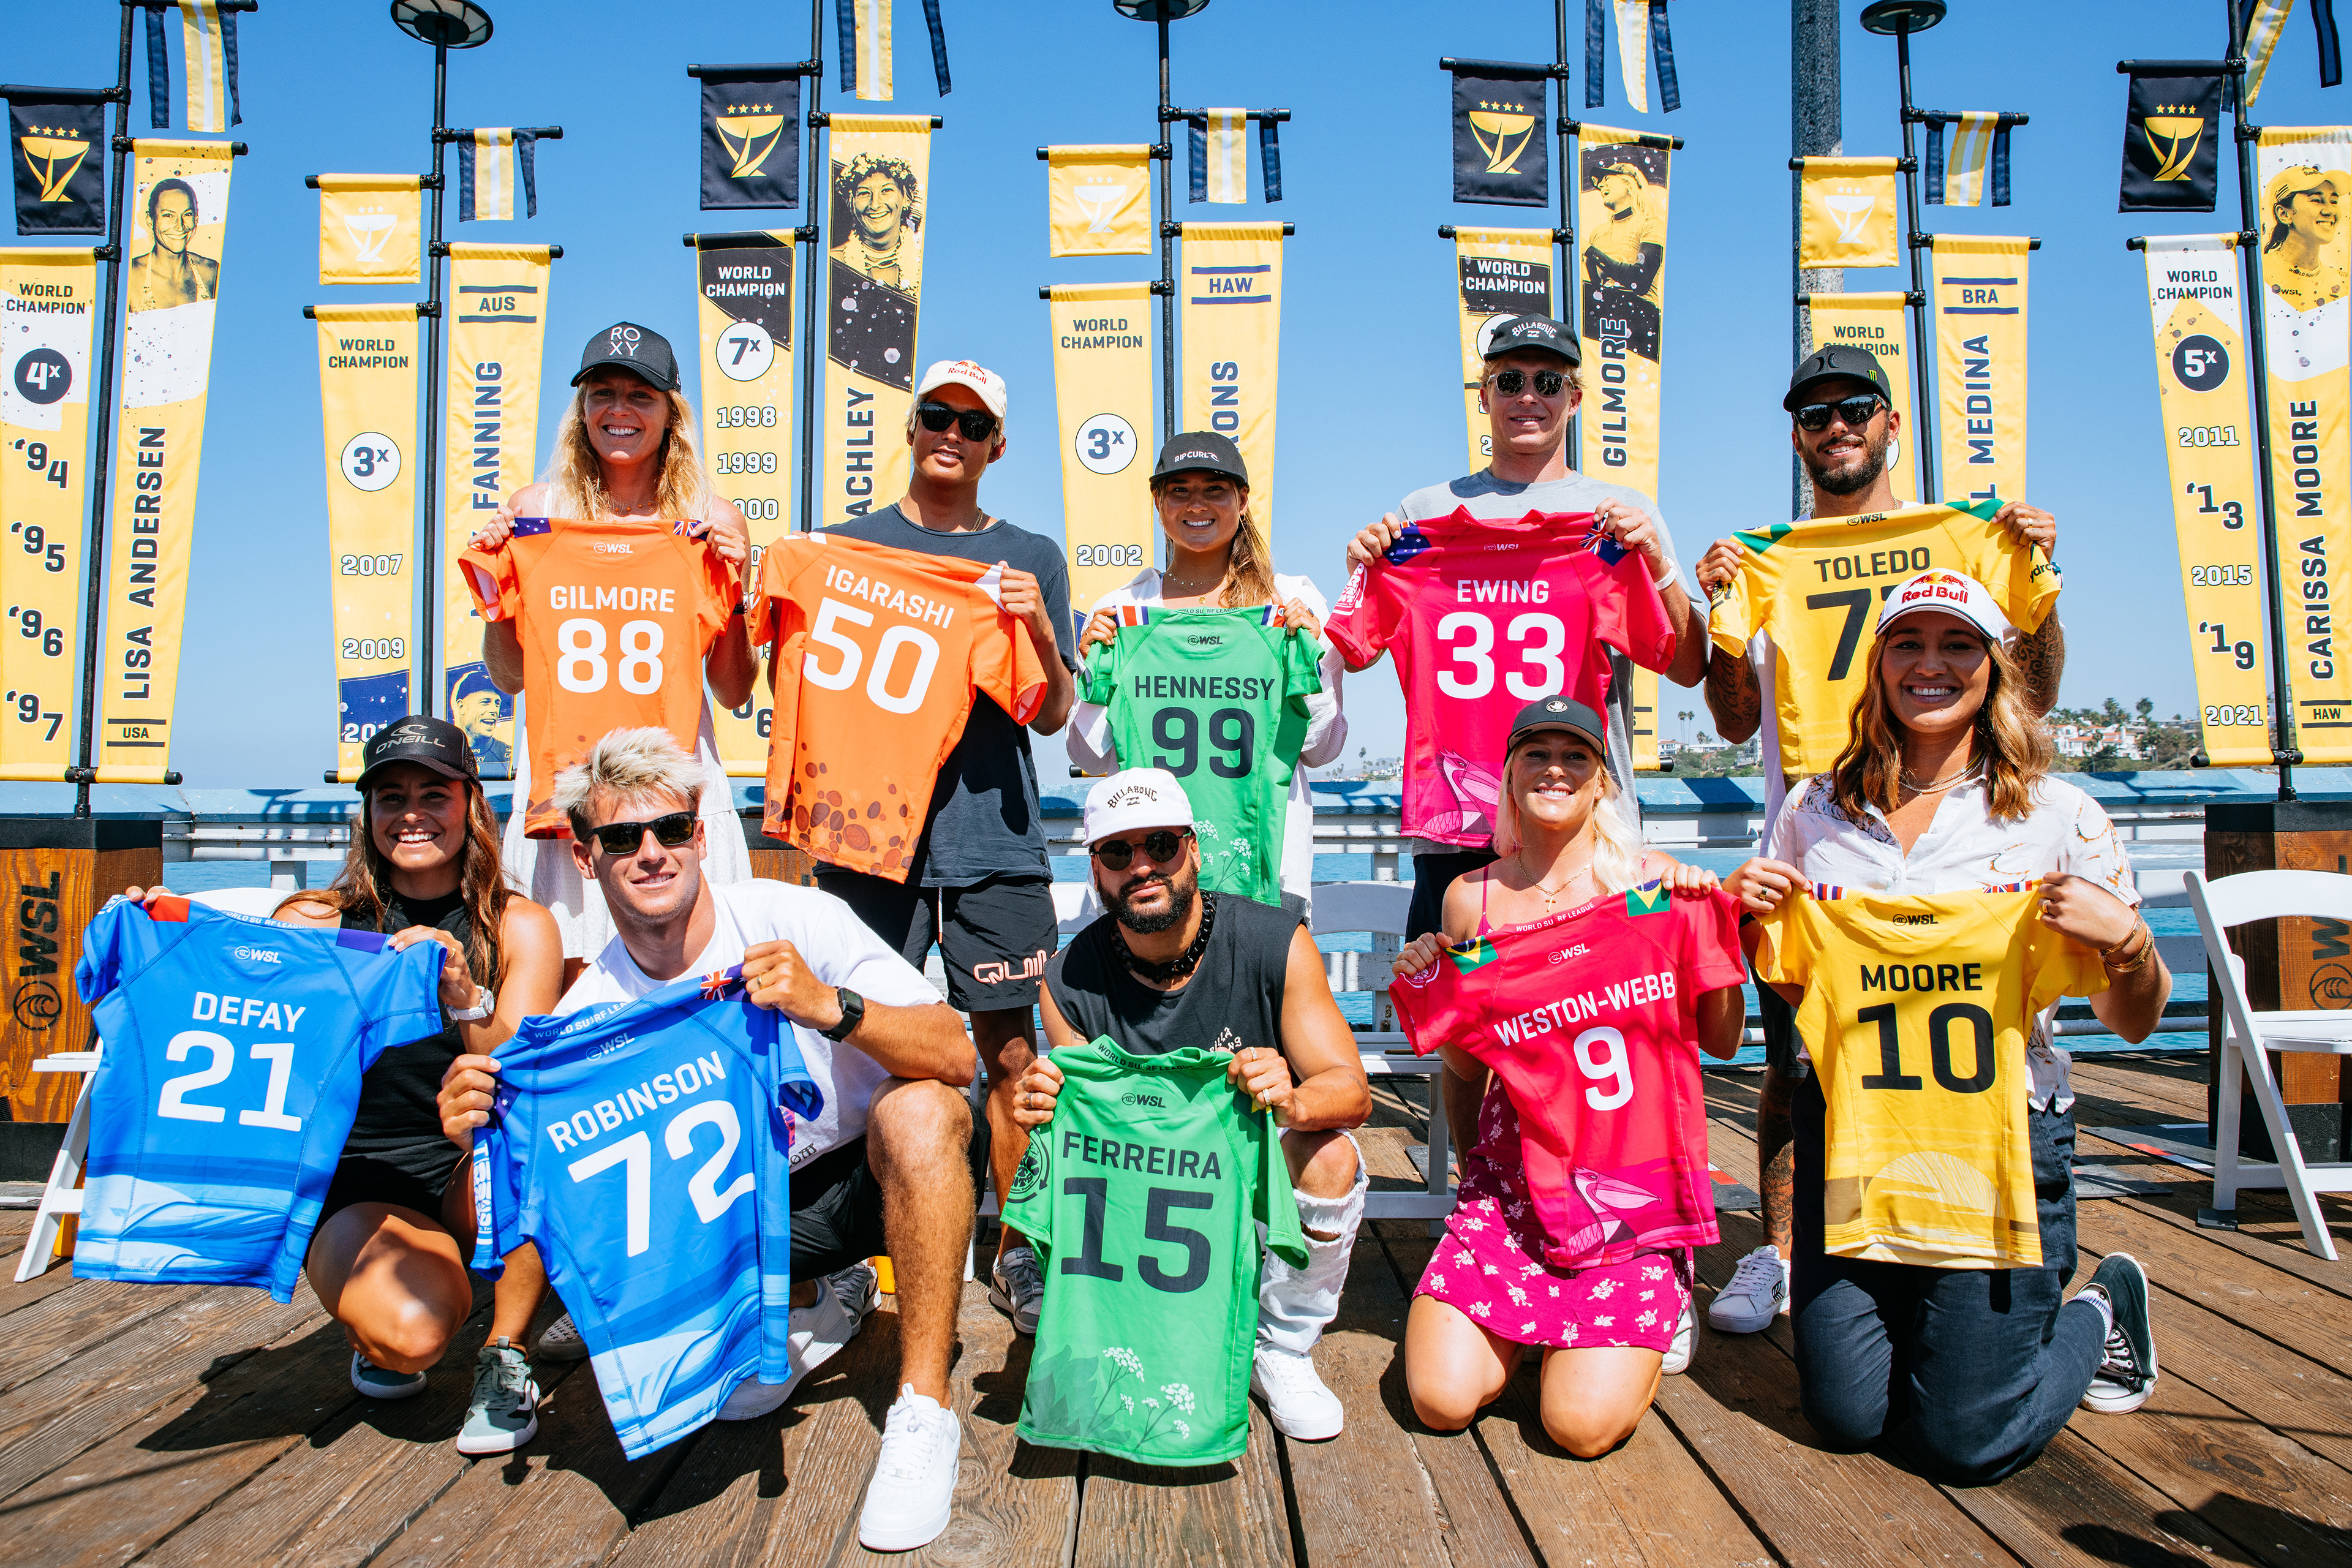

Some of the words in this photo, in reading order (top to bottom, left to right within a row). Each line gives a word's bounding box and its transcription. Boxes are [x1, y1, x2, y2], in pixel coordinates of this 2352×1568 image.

[718, 266, 772, 280] WORLD
[1477, 260, 1531, 277] WORLD
[2167, 270, 2217, 283] WORLD
[19, 283, 74, 298] WORLD
[706, 282, 786, 297] CHAMPION
[1208, 277, 1253, 293] HAW
[1466, 277, 1545, 294] CHAMPION
[2157, 287, 2233, 300] CHAMPION
[6, 299, 86, 314] CHAMPION
[479, 296, 516, 312] AUS
[1962, 289, 1998, 304] BRA
[1073, 318, 1128, 331] WORLD
[1512, 322, 1558, 338] BILLABONG
[1833, 325, 1885, 339] WORLD
[339, 339, 395, 352] WORLD
[1061, 336, 1143, 349] CHAMPION
[328, 356, 409, 369] CHAMPION
[969, 371, 987, 384] Bull
[1210, 361, 1240, 442] ONS
[1600, 317, 1627, 468] GILMORE
[1963, 334, 1995, 465] MEDINA
[717, 406, 777, 429] 1998
[472, 361, 503, 510] FANNING
[2178, 426, 2240, 448] 2011
[717, 452, 777, 474] 1999
[845, 387, 875, 518] ACHLEY
[2290, 400, 2323, 518] MOORE
[129, 428, 167, 608] ANDERSEN
[1860, 513, 1887, 524] WSL
[606, 543, 633, 554] WSL
[1077, 544, 1143, 567] 2002
[341, 554, 403, 576] 2007
[1814, 547, 1931, 582] TOLEDO
[2191, 565, 2253, 587] 2015
[551, 586, 675, 613] GILMORE
[825, 565, 954, 629] IGARASHI
[1457, 580, 1549, 603] EWING
[1901, 585, 1934, 604] Red
[1936, 586, 1968, 603] Bull
[2299, 535, 2335, 680] CARISSA
[1199, 636, 1223, 645] WSL
[1806, 585, 1898, 681] 7
[342, 638, 405, 660] 2009
[557, 618, 664, 695] 88
[803, 597, 940, 715] 50
[1437, 612, 1565, 701] 33
[123, 625, 153, 700] LISA
[1134, 676, 1275, 701] HENNESSY
[2204, 705, 2264, 726] 2021
[2313, 707, 2341, 720] HAW
[123, 726, 149, 739] USA
[1152, 707, 1255, 778] 99
[1107, 785, 1158, 809] BILLABONG
[20, 872, 60, 976] WSL
[1516, 922, 1542, 932] WORLD
[1568, 902, 1594, 918] LEAGUE
[1907, 913, 1939, 925] WSL
[251, 949, 282, 963] WSL
[1561, 943, 1591, 960] WSL
[1860, 963, 1983, 992] MOORE
[192, 992, 306, 1033] DEFAY
[1493, 971, 1676, 1047] WESTON-WEBB
[535, 1024, 573, 1038] WORLD
[600, 1033, 635, 1054] WSL
[1098, 1043, 1126, 1066] WORLD
[1857, 1002, 1996, 1093] 10
[1574, 1027, 1634, 1111] 9
[157, 1030, 302, 1132] 21
[547, 1051, 726, 1153] ROBINSON
[1137, 1094, 1166, 1108] WSL
[1063, 1131, 1222, 1180] FERREIRA
[568, 1100, 756, 1257] 72
[1061, 1177, 1215, 1294] 15
